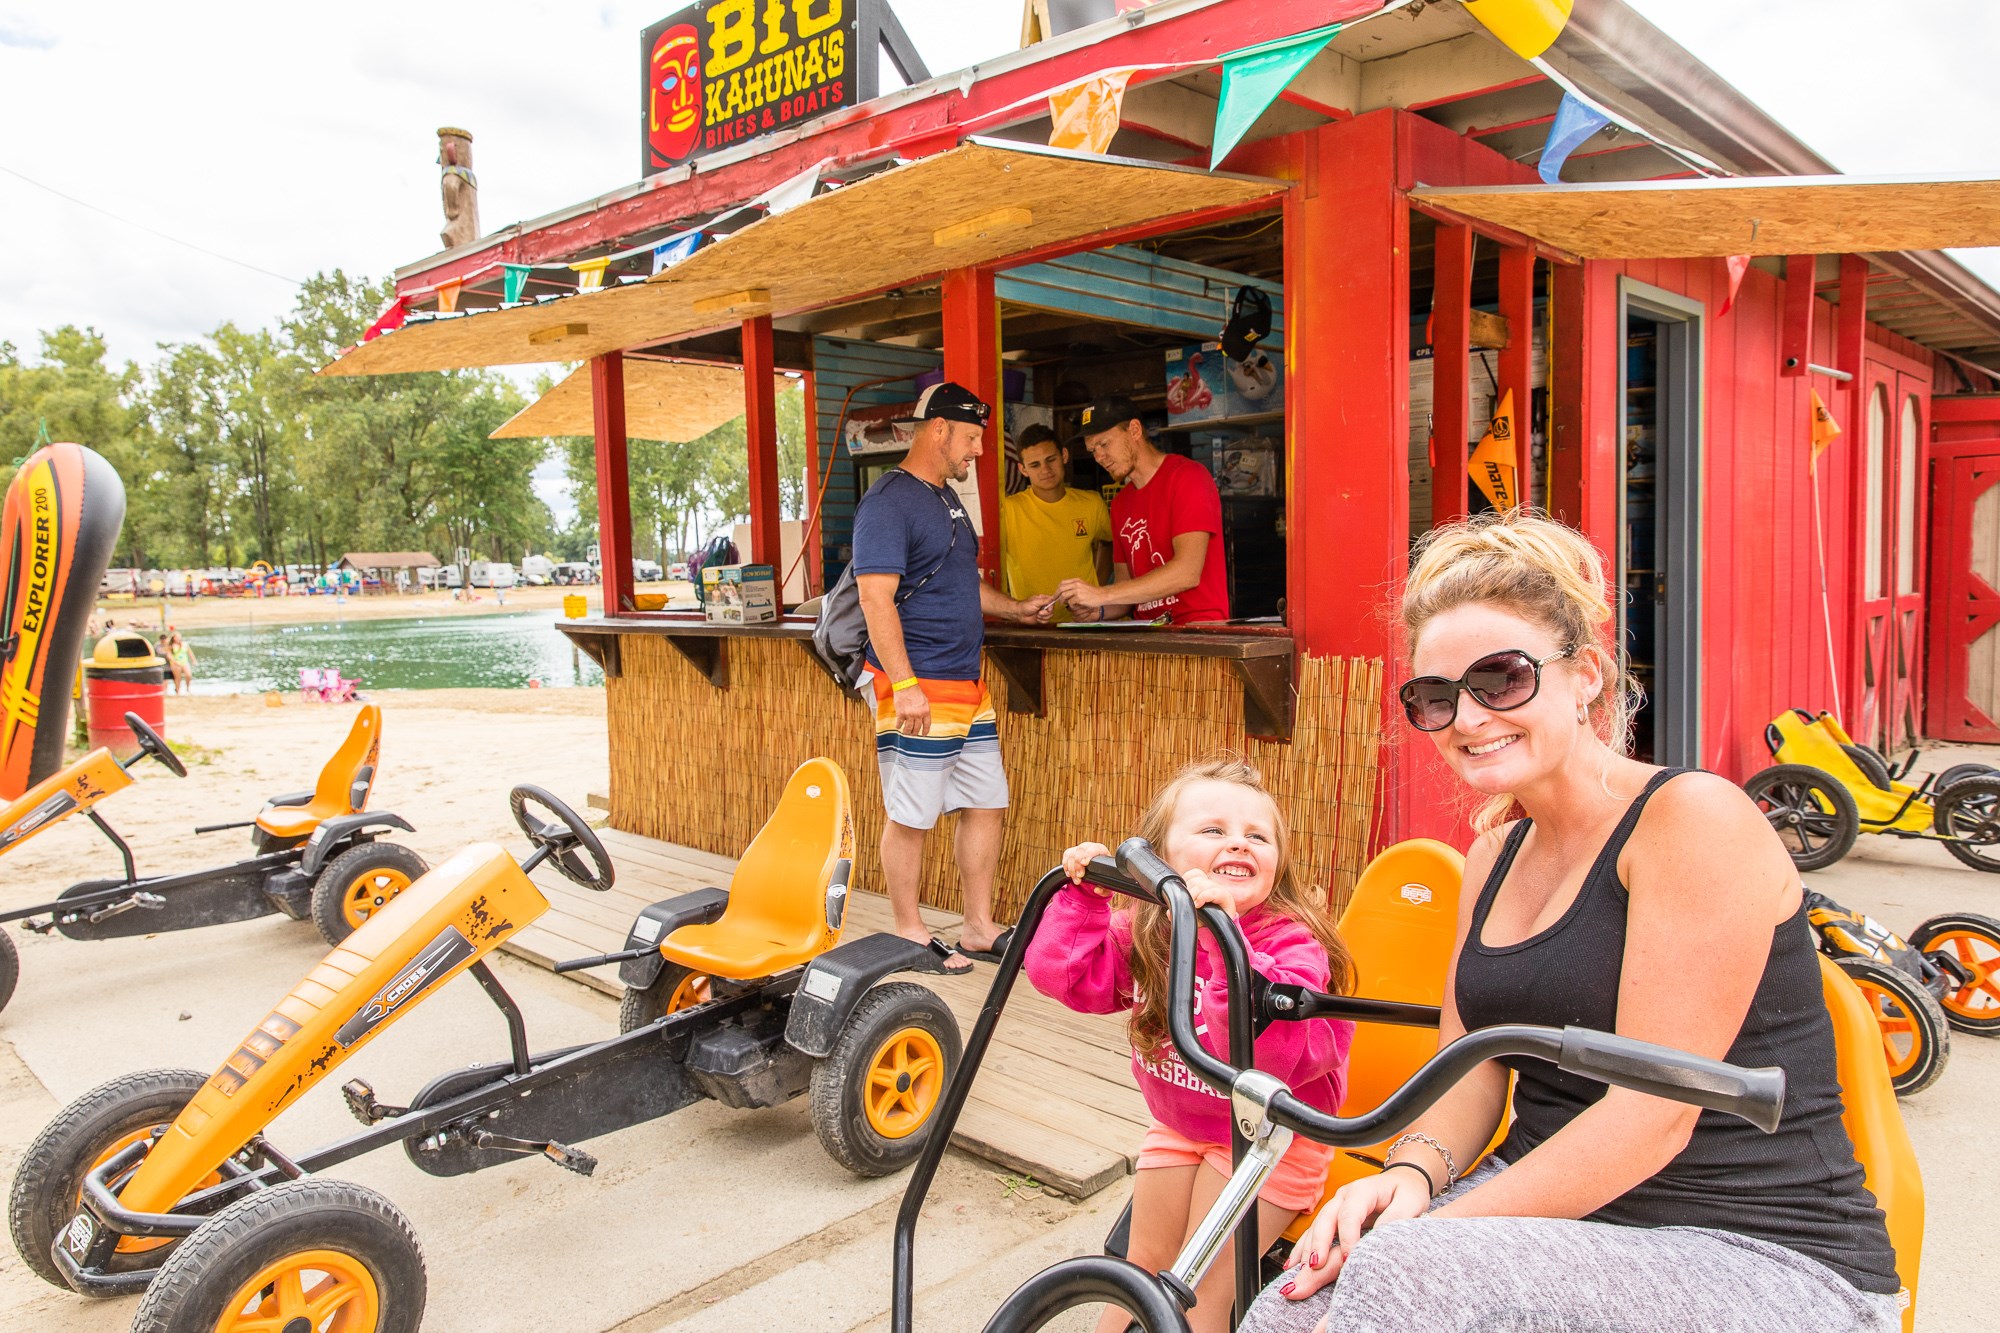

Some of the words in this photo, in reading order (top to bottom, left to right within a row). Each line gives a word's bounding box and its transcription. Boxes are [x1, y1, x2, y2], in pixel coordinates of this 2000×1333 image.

[705, 29, 845, 127] KAHUNA'S
[705, 116, 756, 149] BIKES
[761, 108, 775, 128] &
[780, 81, 844, 122] BOATS
[34, 488, 49, 513] 200
[23, 517, 50, 633] EXPLORER
[1166, 595, 1180, 605] CO.
[1402, 887, 1431, 901] BERG
